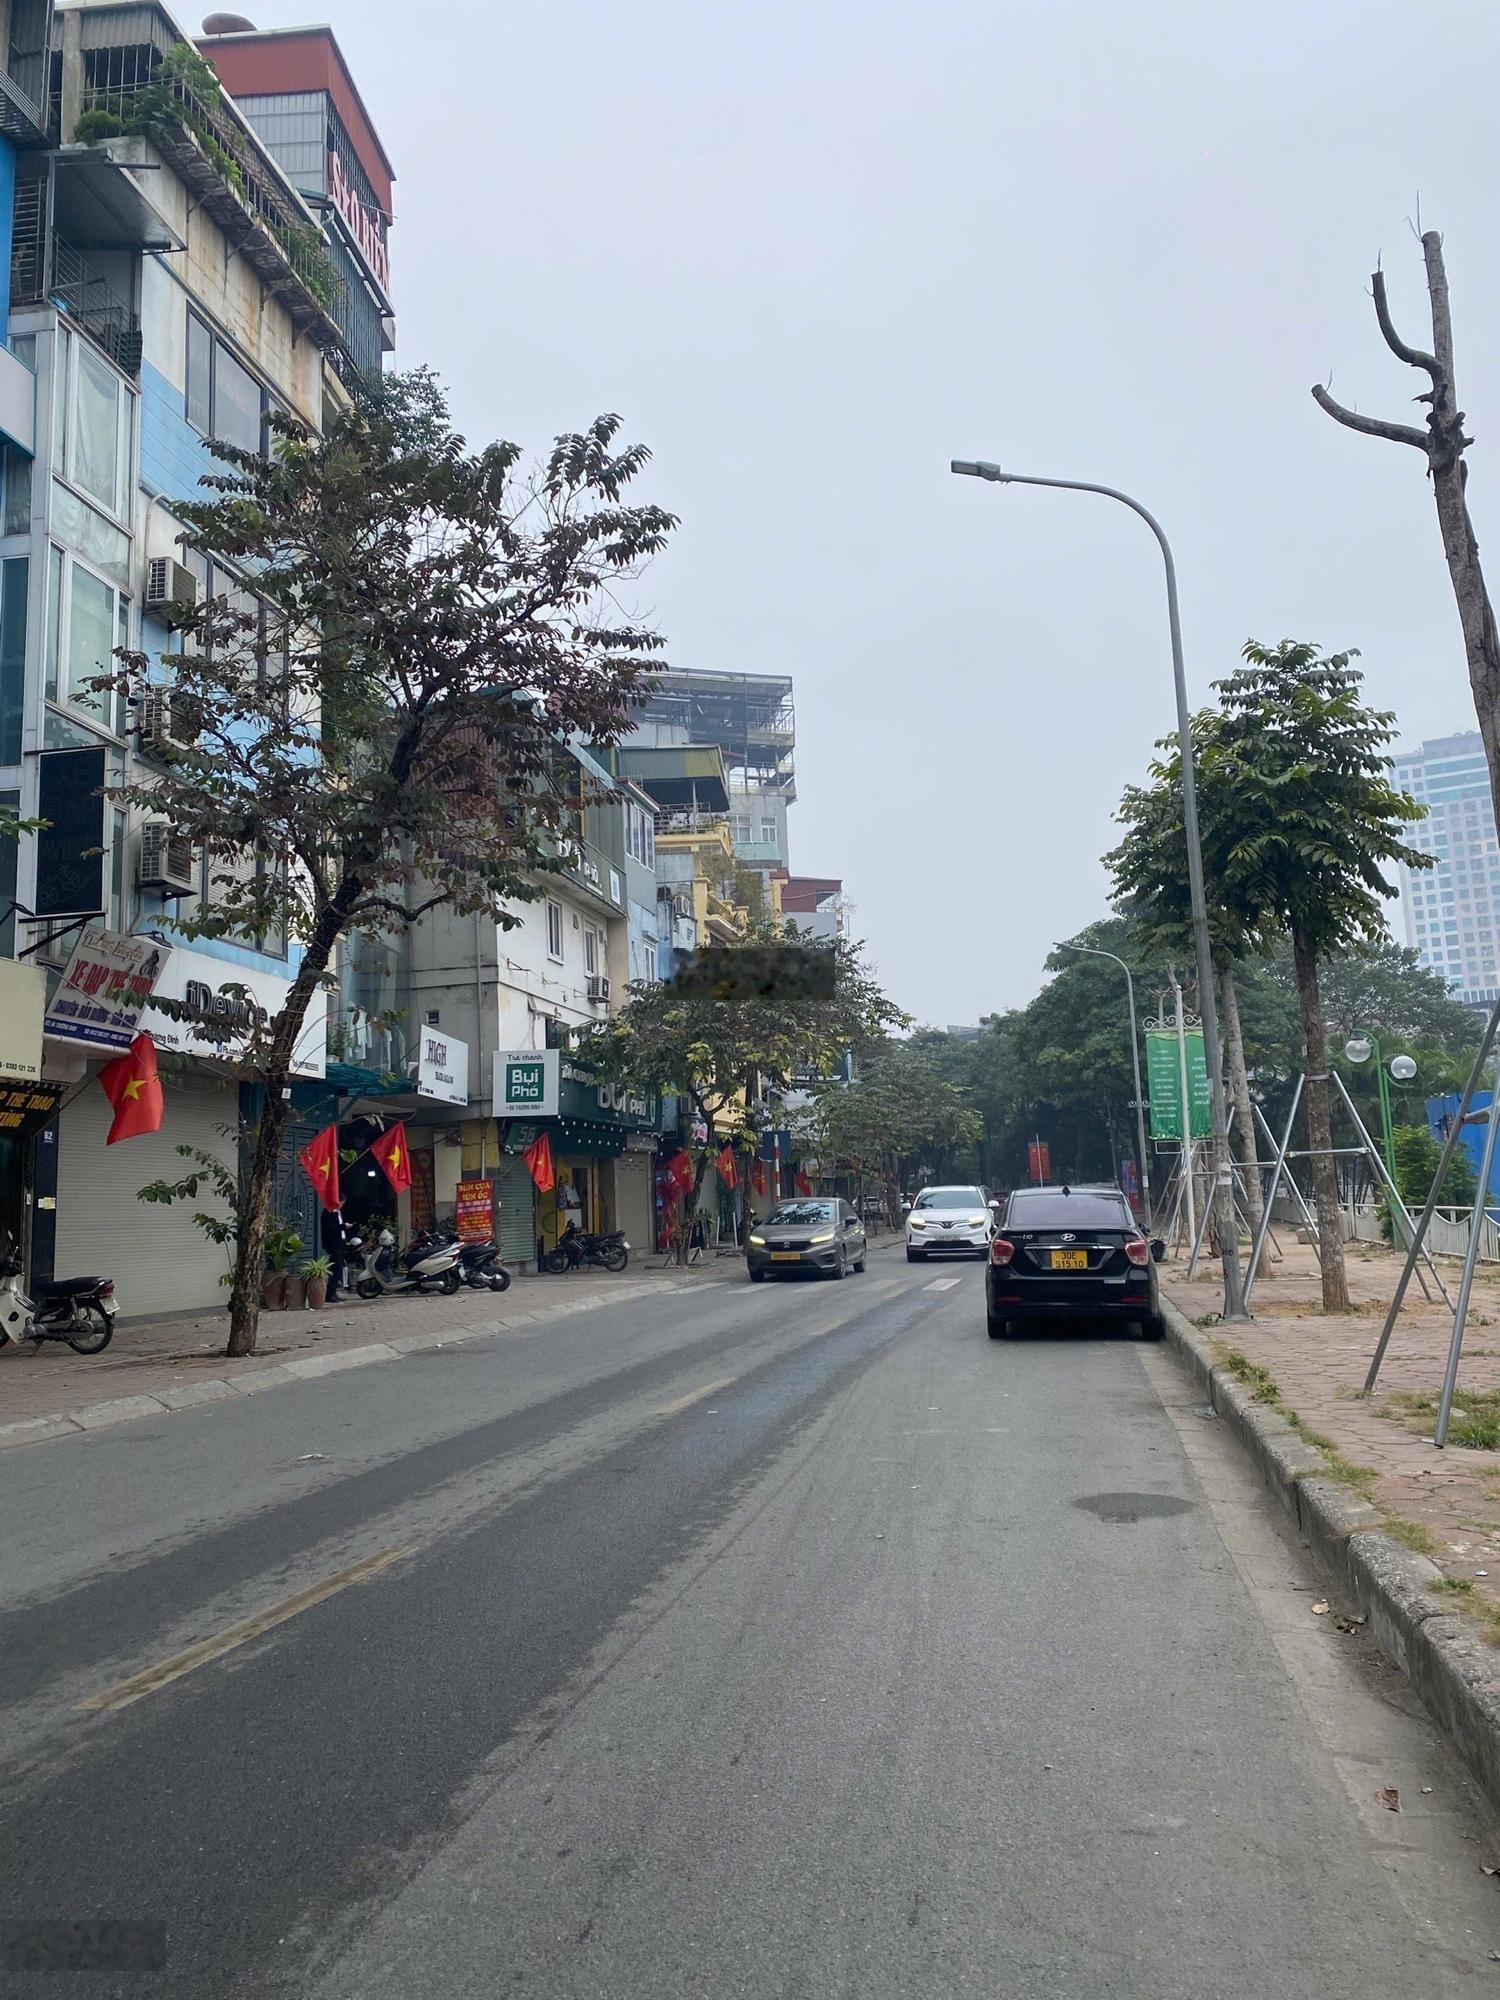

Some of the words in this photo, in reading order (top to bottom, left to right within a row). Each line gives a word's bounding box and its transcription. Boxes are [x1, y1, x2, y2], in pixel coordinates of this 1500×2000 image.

[425, 1039, 447, 1066] HIGH
[511, 1068, 539, 1086] Bụi
[26, 1094, 56, 1111] THAO
[1061, 1251, 1077, 1260] 30E
[1055, 1260, 1084, 1269] 915.10
